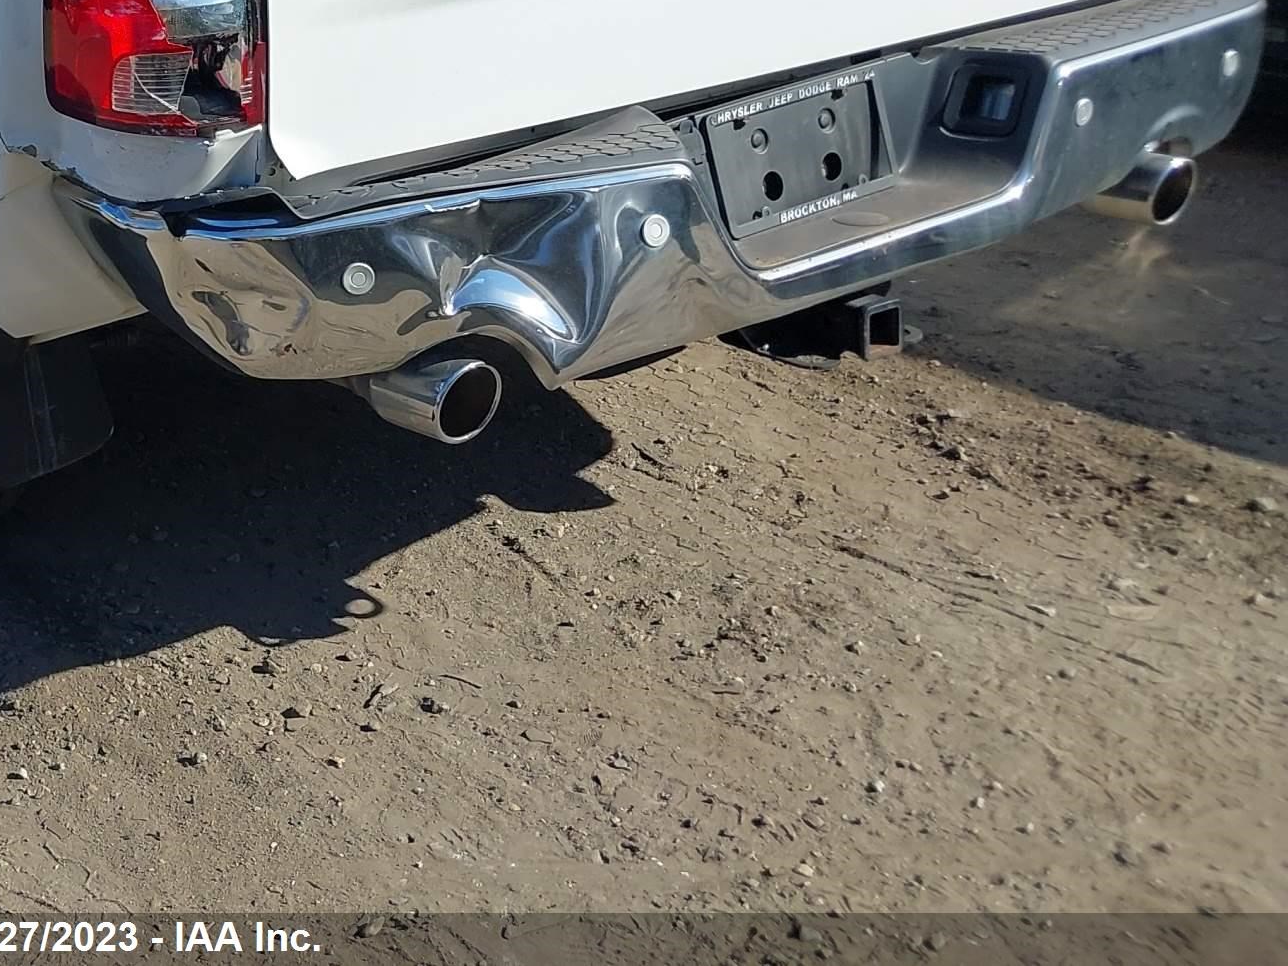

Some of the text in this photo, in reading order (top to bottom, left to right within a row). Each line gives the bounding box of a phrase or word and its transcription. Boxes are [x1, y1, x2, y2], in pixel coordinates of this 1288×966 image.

[711, 101, 763, 126] CHRYSLER
[768, 92, 793, 109] JEEP
[799, 81, 832, 99] DODGE
[836, 73, 859, 88] RAM
[842, 190, 859, 202] MA
